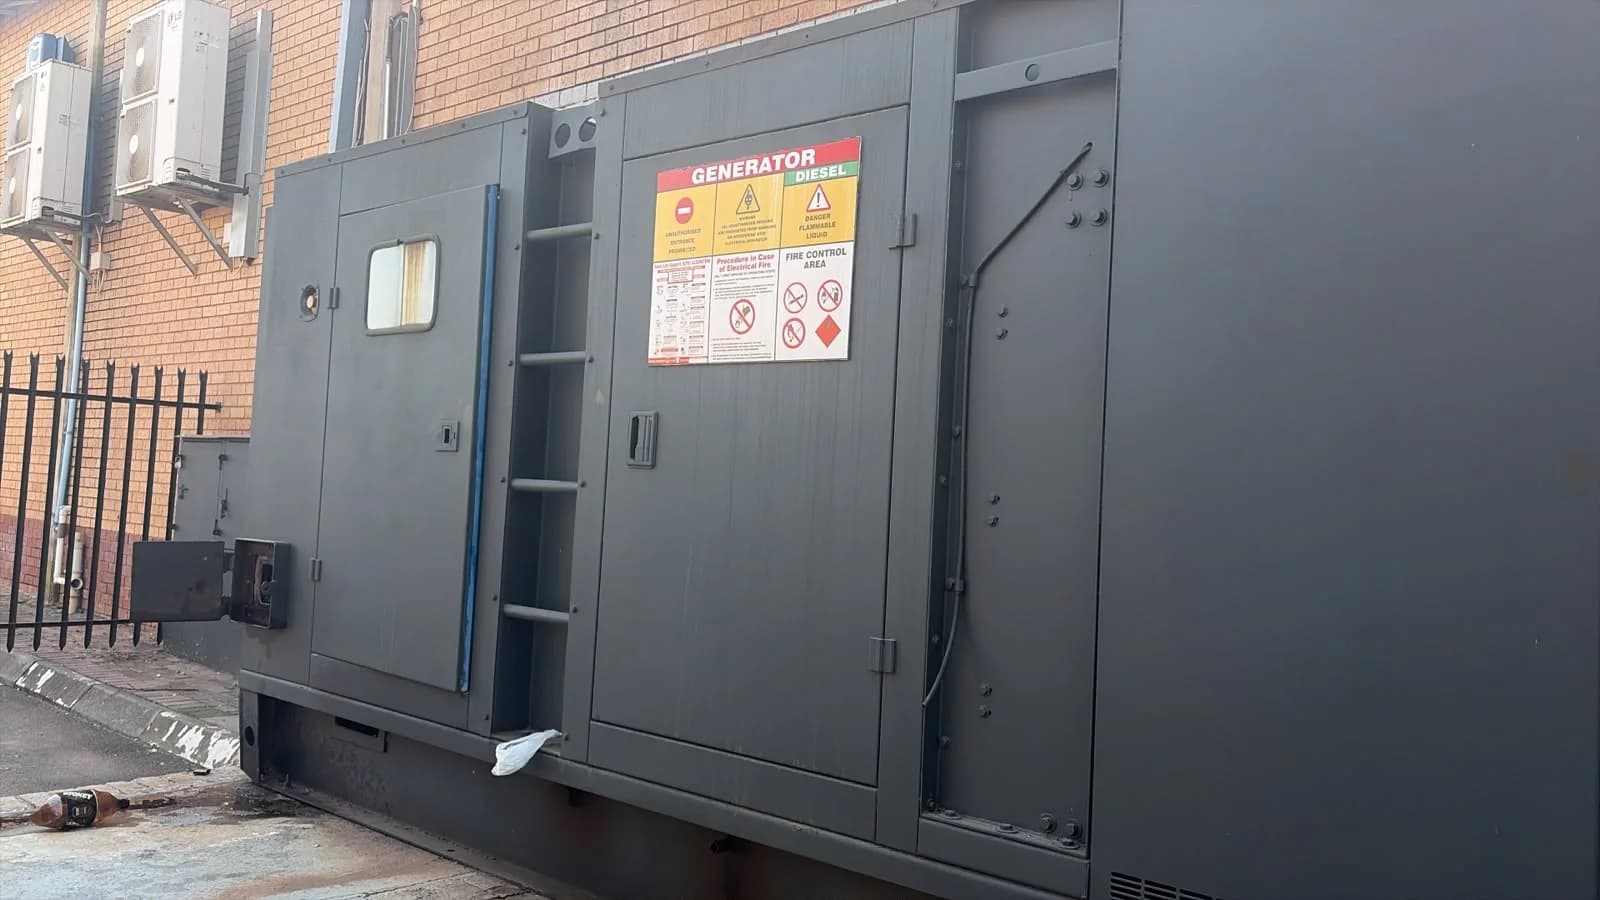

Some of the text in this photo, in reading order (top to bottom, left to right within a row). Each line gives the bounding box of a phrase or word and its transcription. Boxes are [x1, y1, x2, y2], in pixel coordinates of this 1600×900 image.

[691, 148, 816, 185] GENERATOR
[795, 165, 846, 182] DIESEL
[805, 213, 831, 222] DANGER
[799, 221, 836, 231] FLAMMABLE
[806, 231, 828, 240] LIQUID
[717, 256, 749, 265] Procedure
[758, 253, 775, 262] Case
[786, 247, 847, 262] FIRE CONTROL
[727, 262, 757, 272] Electrical
[758, 260, 772, 269] Fire
[804, 260, 826, 269] AREA
